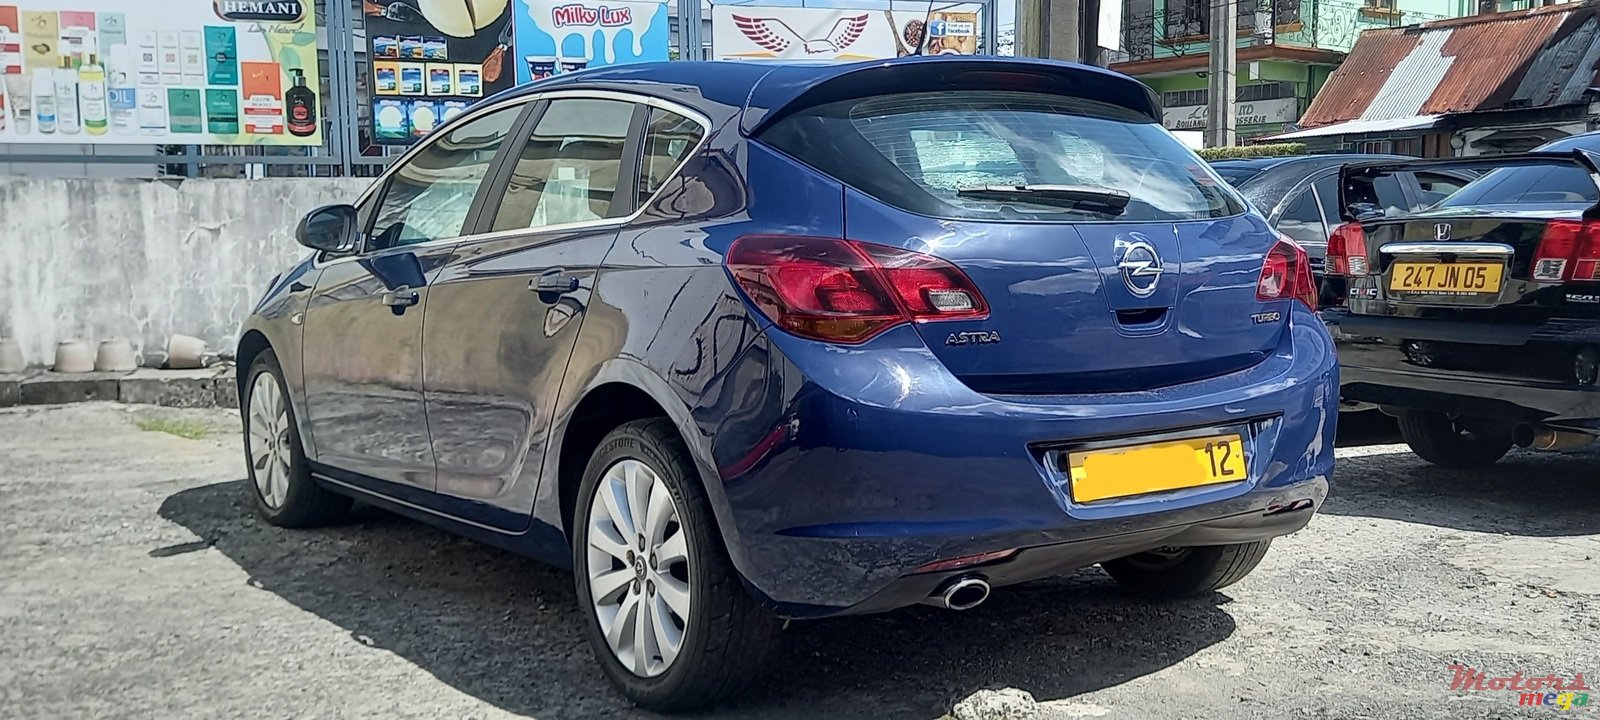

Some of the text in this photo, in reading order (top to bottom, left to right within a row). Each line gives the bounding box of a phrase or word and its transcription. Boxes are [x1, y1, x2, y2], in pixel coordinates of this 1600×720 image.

[223, 1, 298, 15] HEMANI
[555, 7, 630, 26] Milky Lux
[108, 89, 131, 103] OIL
[1175, 115, 1267, 129] BOULANG ISSERIE
[1402, 266, 1487, 289] 247 JN 05
[1350, 288, 1377, 296] CIVIC
[1250, 312, 1281, 325] TURBO
[945, 330, 1001, 346] ASTRA
[1204, 440, 1235, 478] 12
